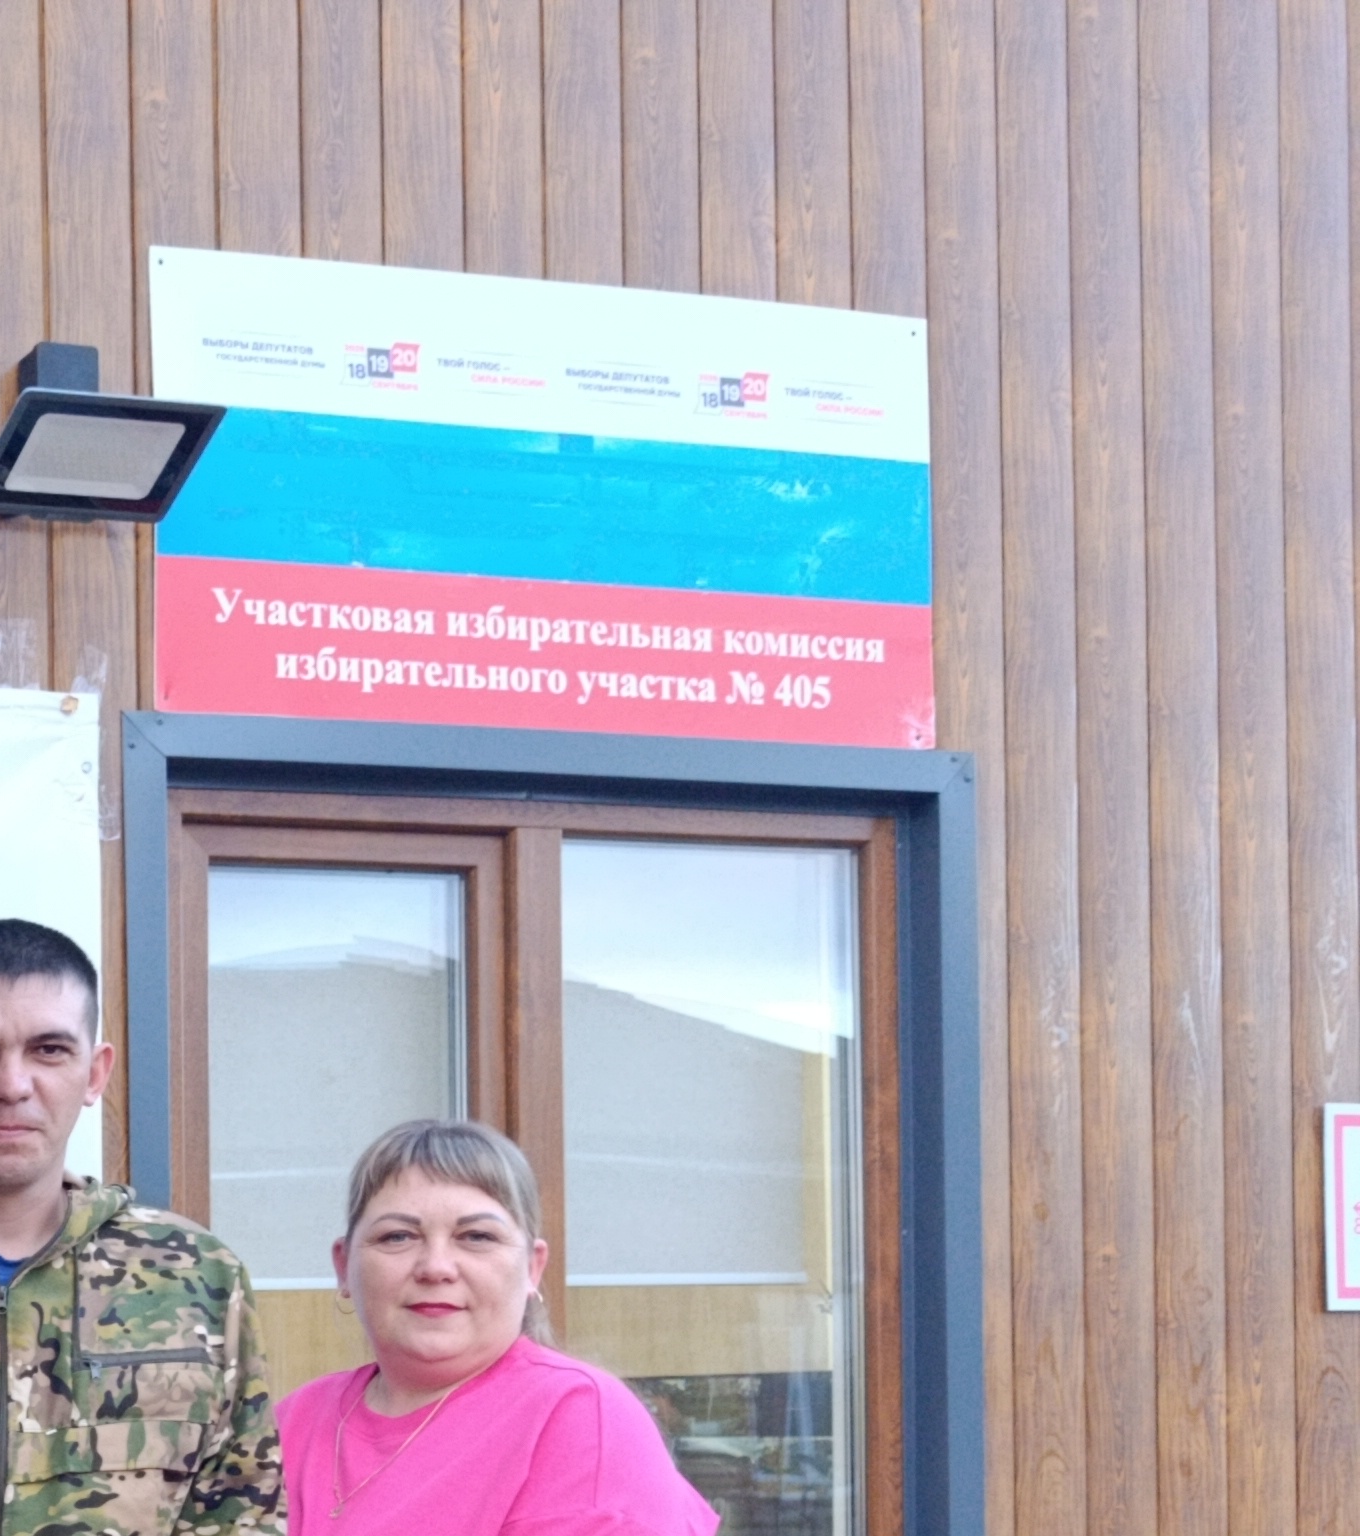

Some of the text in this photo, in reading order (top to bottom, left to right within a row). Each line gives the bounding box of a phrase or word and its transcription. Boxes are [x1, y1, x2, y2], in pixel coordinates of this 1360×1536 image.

[202, 337, 314, 355] ВЫБОРЫ ДЕПУТАТОВ
[348, 348, 417, 379] 18 19 20
[437, 357, 464, 369] ТВОЙ
[466, 360, 501, 372] ГОЛОС
[612, 371, 670, 385] ДЕПУТАТОВ
[701, 377, 766, 408] 18 19 20
[784, 386, 810, 398] ТВОЙ
[812, 389, 844, 401] ГОЛОС
[211, 587, 886, 663] Участковая избирательная комиссия
[275, 647, 832, 710] избирательного участка № 405
